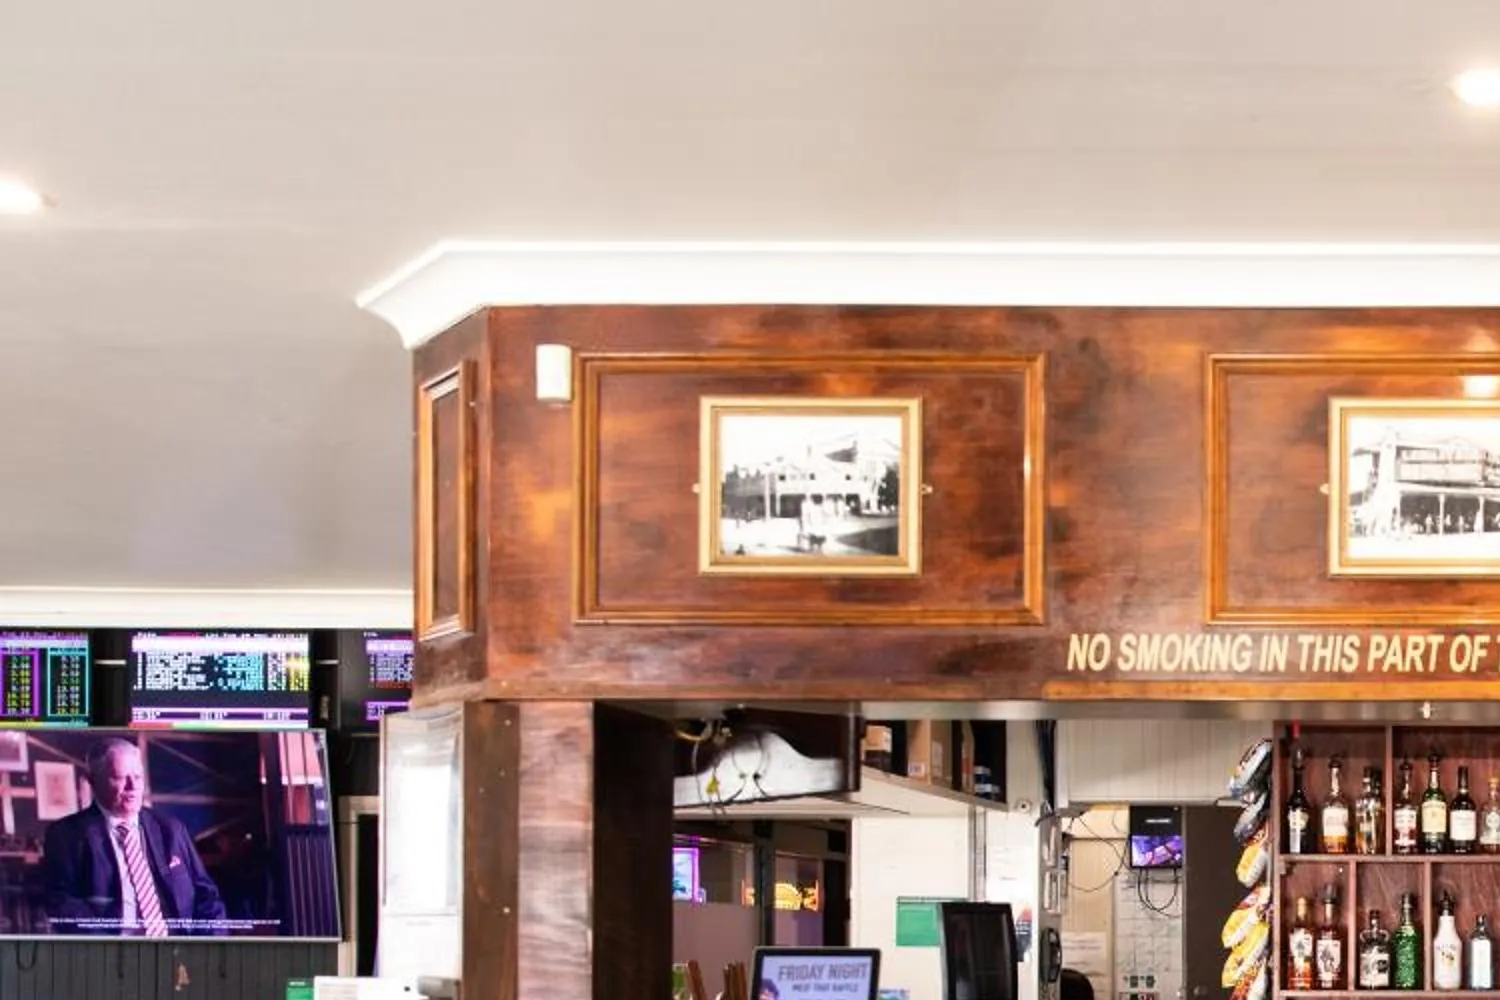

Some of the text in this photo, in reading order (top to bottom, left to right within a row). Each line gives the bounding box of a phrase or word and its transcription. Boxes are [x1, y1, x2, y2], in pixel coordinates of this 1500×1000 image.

[1067, 632, 1111, 672] NO
[1117, 632, 1253, 673] SMOKING
[1259, 633, 1290, 673] IN
[1298, 634, 1359, 673] THIS
[1367, 634, 1444, 673] PART
[1451, 634, 1490, 673] OF
[779, 962, 868, 981] FRIDAY NIGHT
